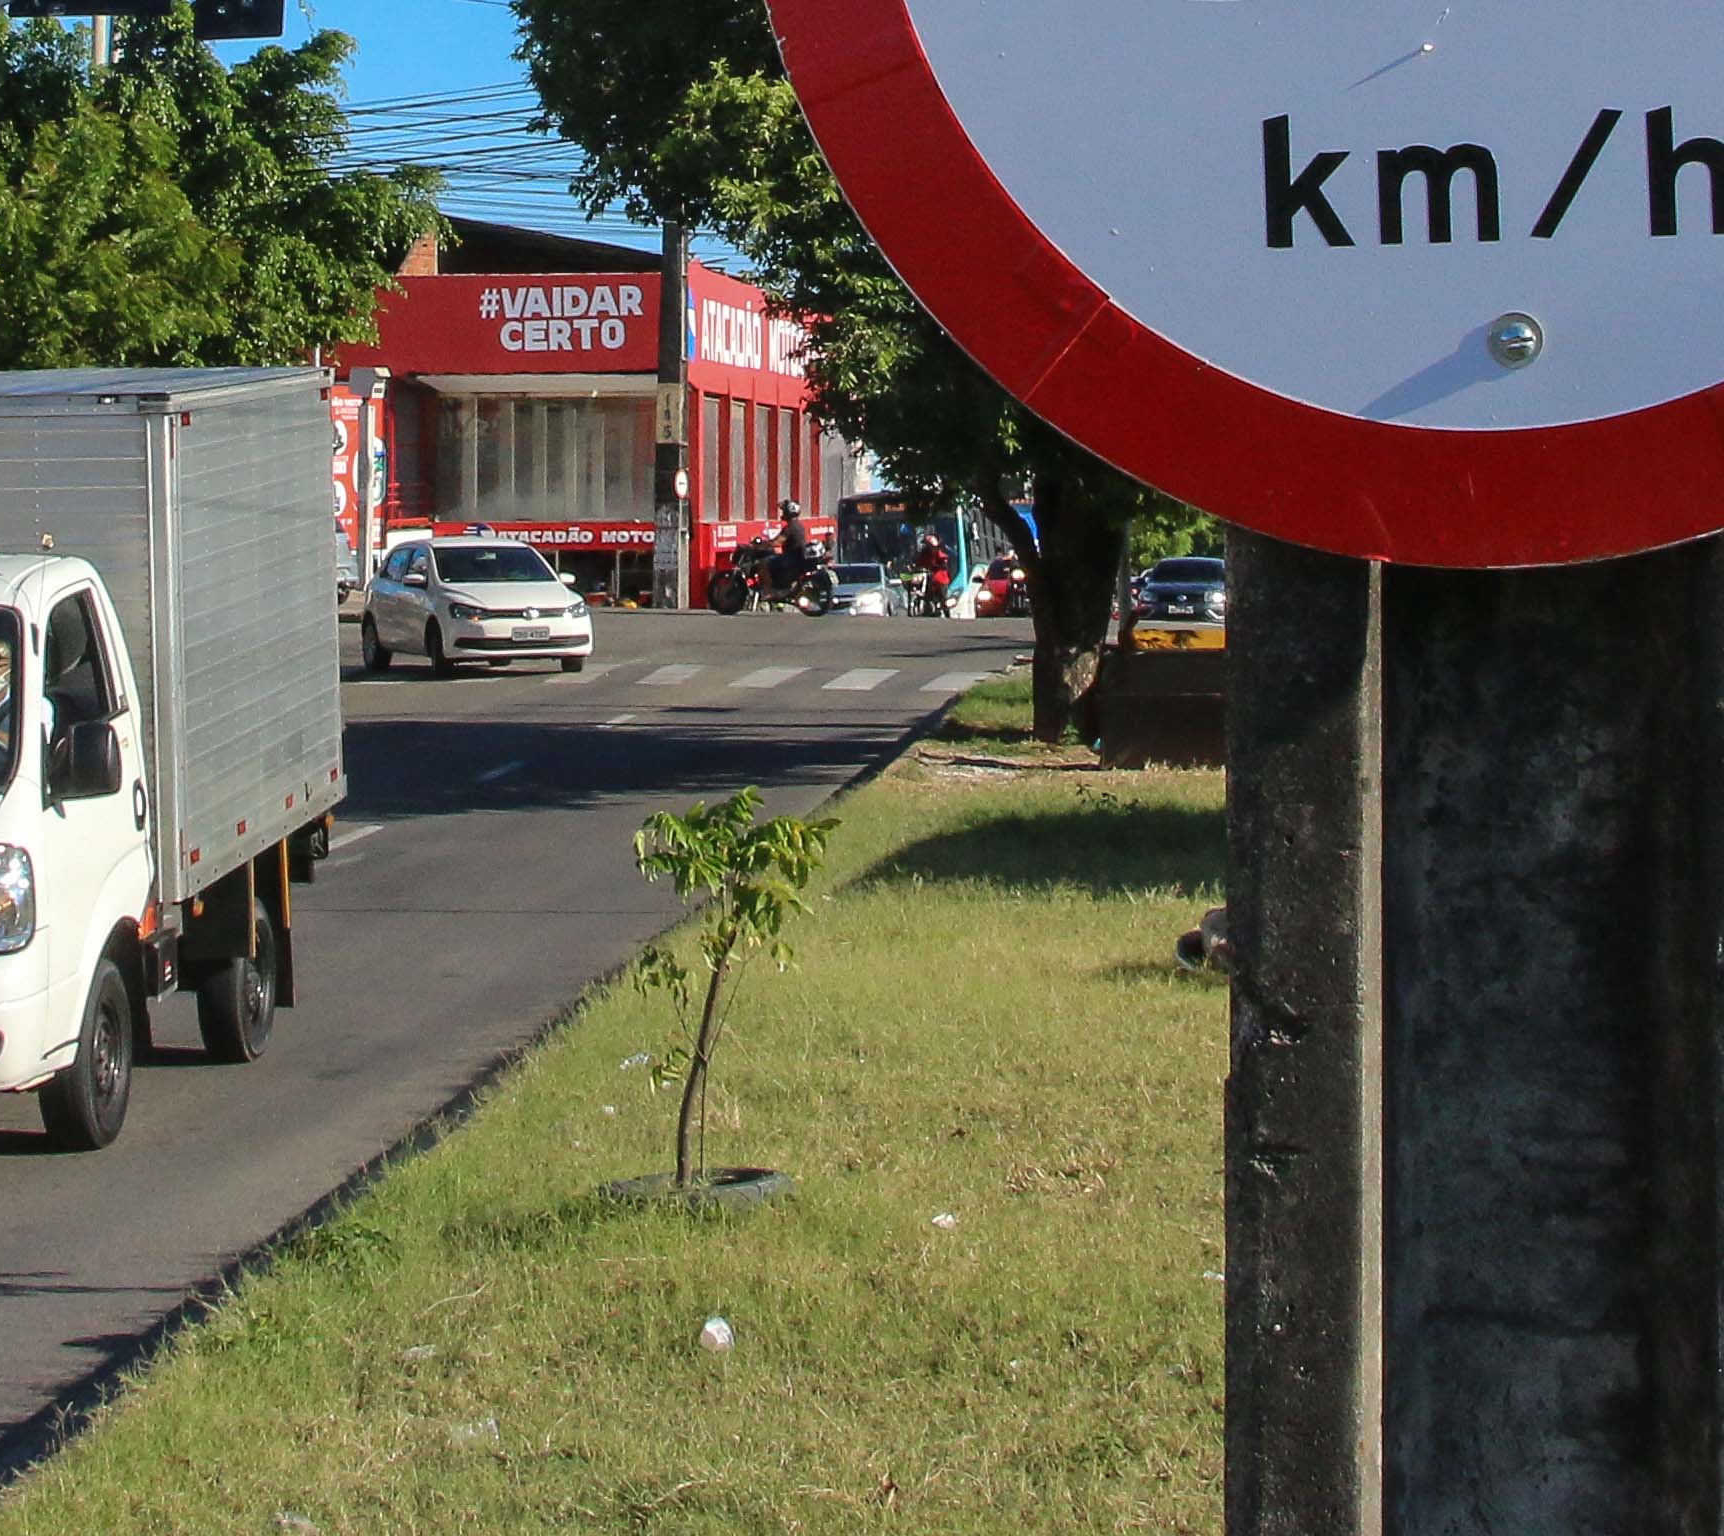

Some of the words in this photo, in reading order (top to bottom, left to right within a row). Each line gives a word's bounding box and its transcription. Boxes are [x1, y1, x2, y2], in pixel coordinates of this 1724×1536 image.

[480, 285, 644, 320] #VAIDAR
[500, 319, 626, 352] CERTO
[701, 298, 763, 370] ATACADÃO
